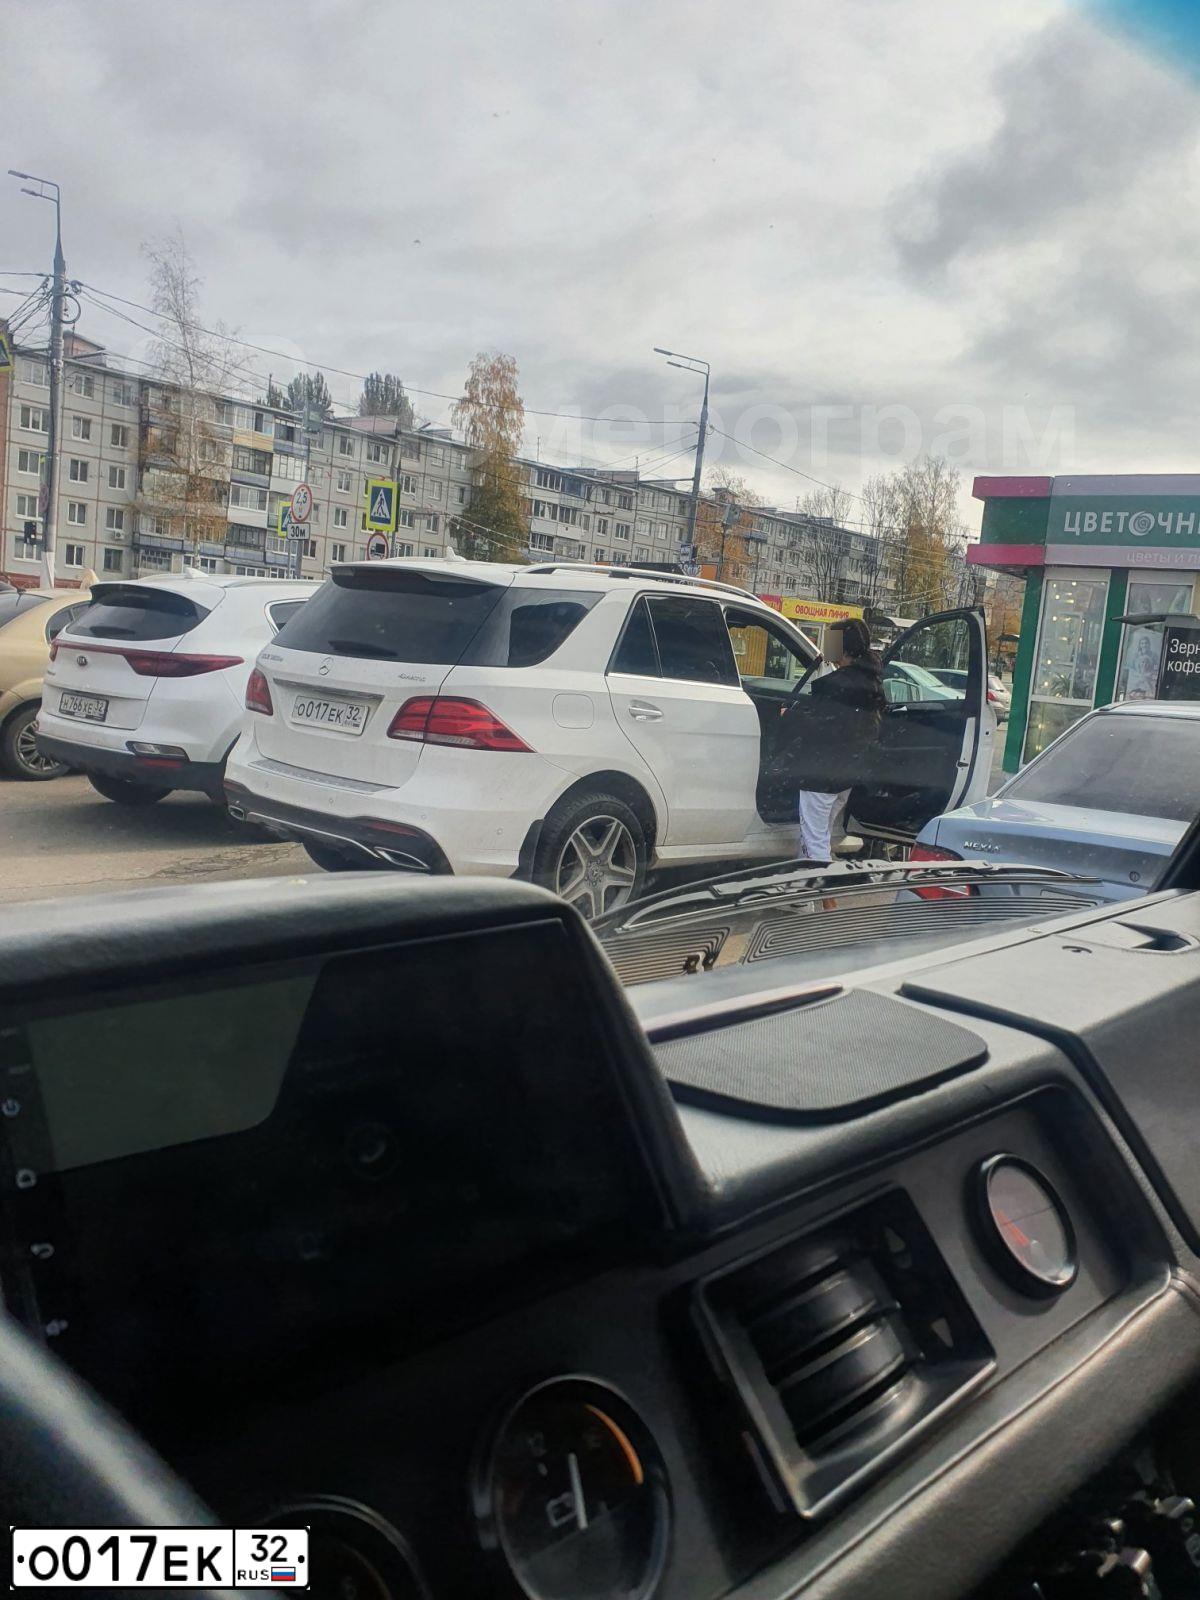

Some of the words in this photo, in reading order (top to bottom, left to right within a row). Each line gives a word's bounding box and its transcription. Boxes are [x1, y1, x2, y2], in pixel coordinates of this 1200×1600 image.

[1064, 511, 1200, 536] ЦВЕТОЧН
[1127, 551, 1170, 564] цветы
[1174, 553, 1184, 563] и
[795, 604, 828, 617] ОВОЩНАЯ
[1167, 660, 1200, 675] кофе
[346, 706, 360, 720] 32
